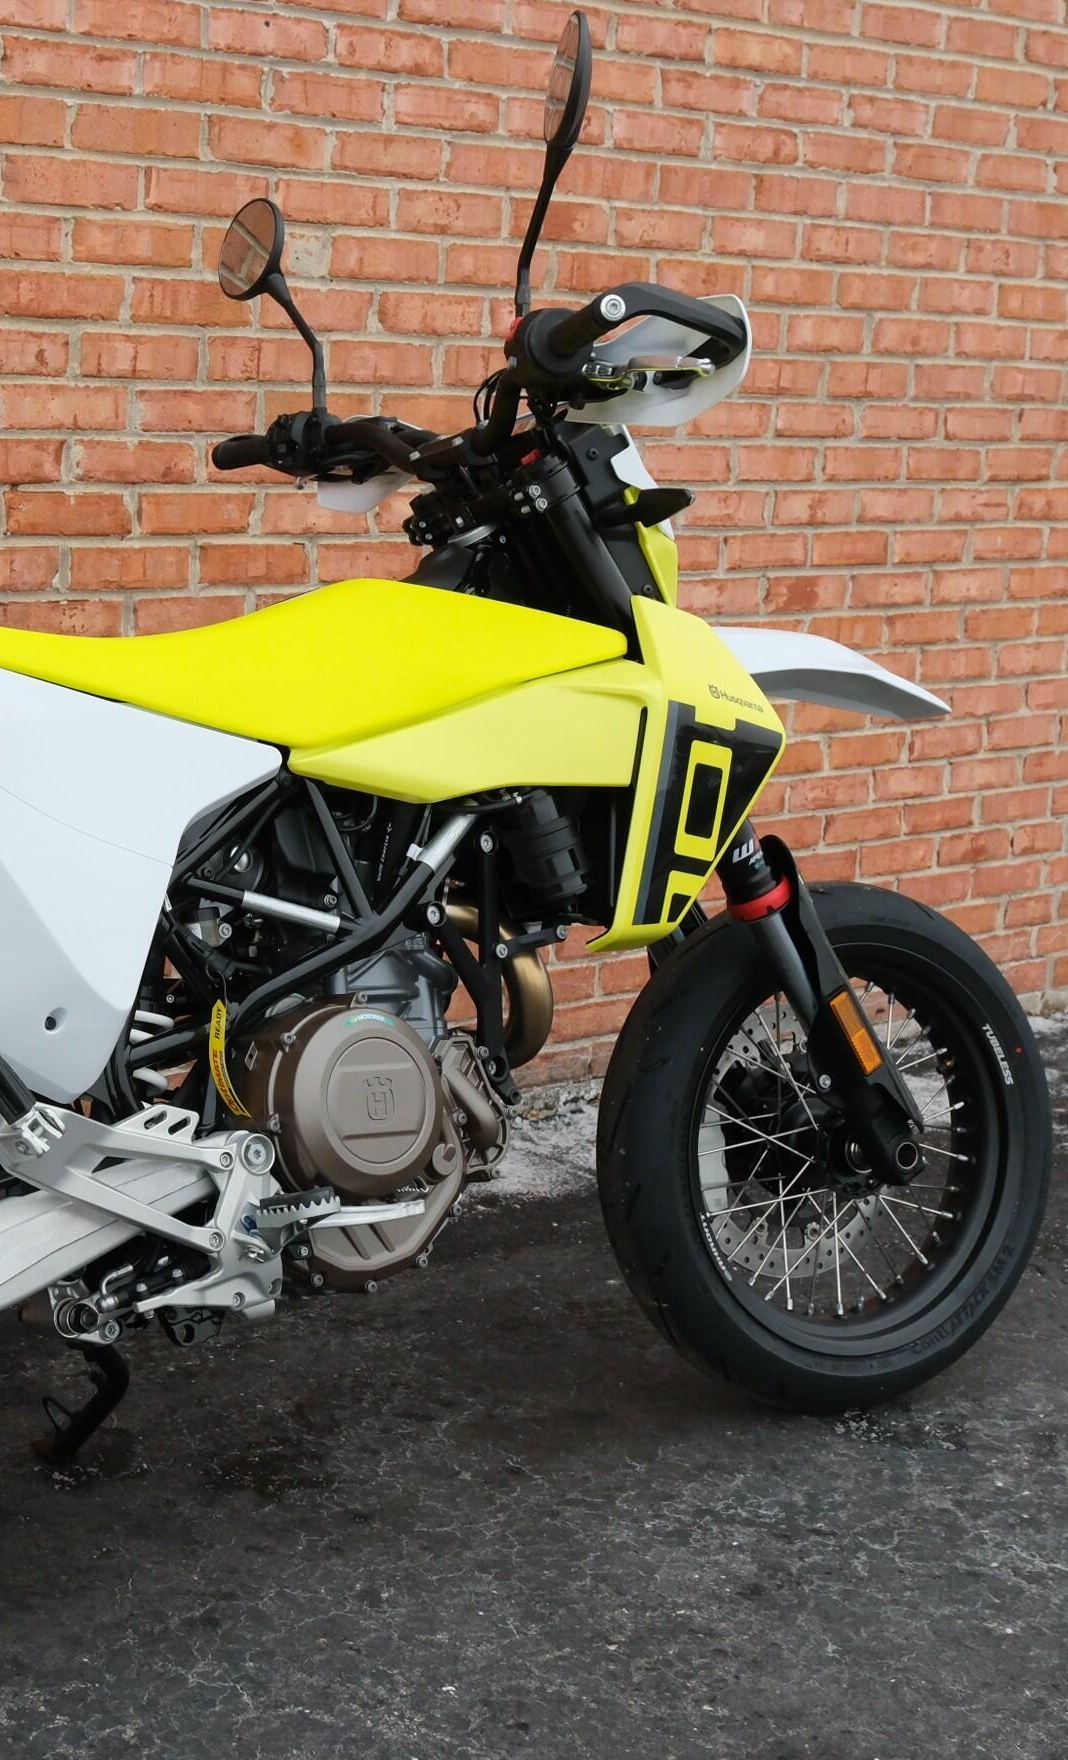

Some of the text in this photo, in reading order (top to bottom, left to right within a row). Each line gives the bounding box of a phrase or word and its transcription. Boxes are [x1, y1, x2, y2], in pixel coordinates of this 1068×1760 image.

[719, 690, 764, 713] Husqvarna
[215, 1005, 223, 1040] READY
[982, 1023, 1014, 1086] TUBELESS
